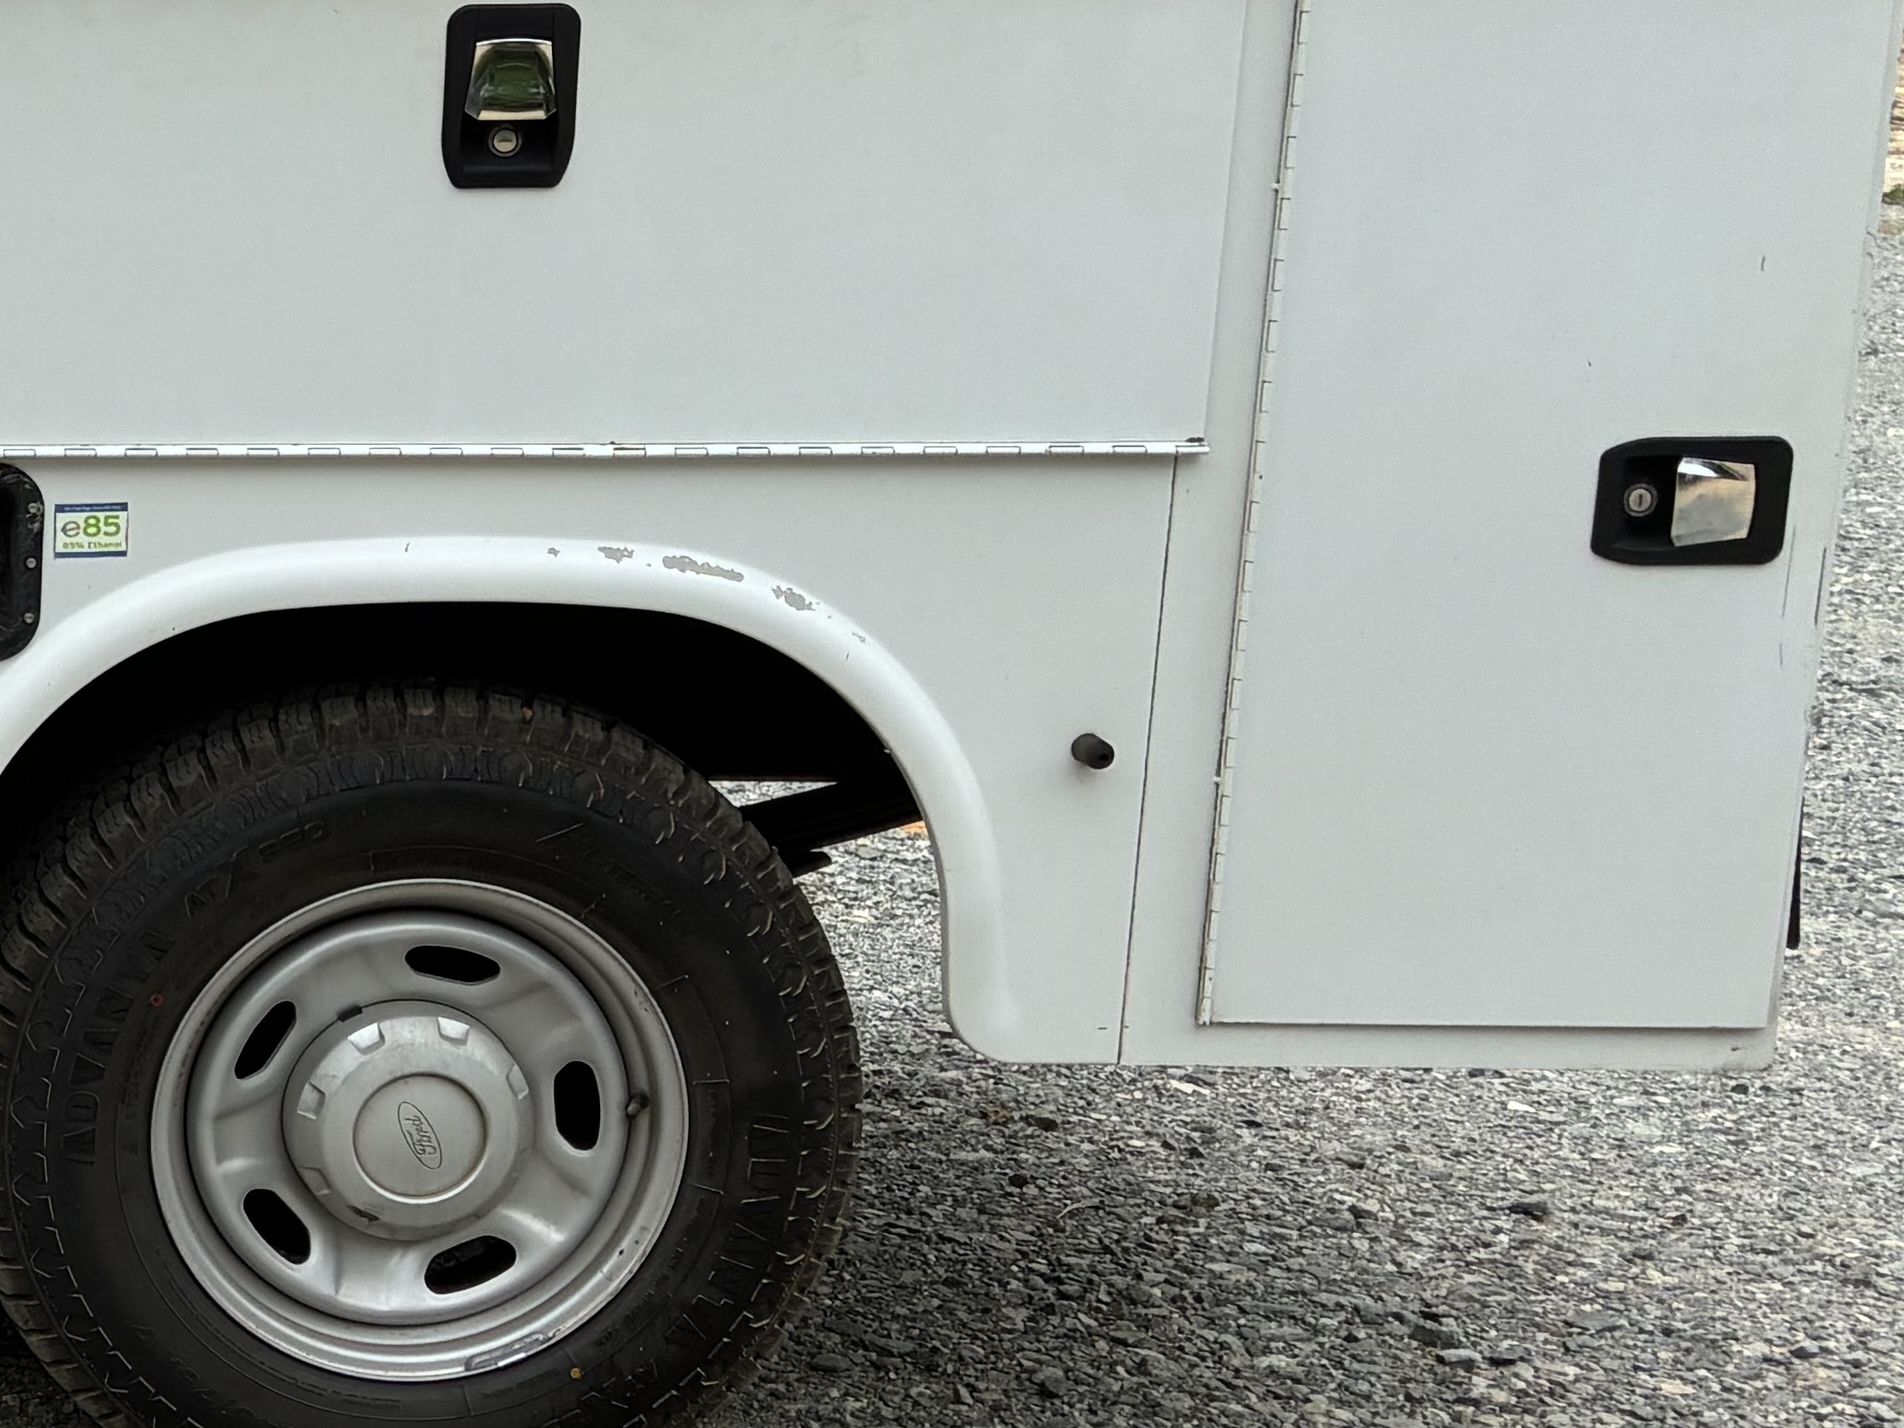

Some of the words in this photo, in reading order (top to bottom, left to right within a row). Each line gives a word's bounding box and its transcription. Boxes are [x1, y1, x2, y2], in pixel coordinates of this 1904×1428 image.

[60, 514, 121, 538] e85
[59, 927, 176, 1166] ADVANTA
[404, 1115, 437, 1155] Ford
